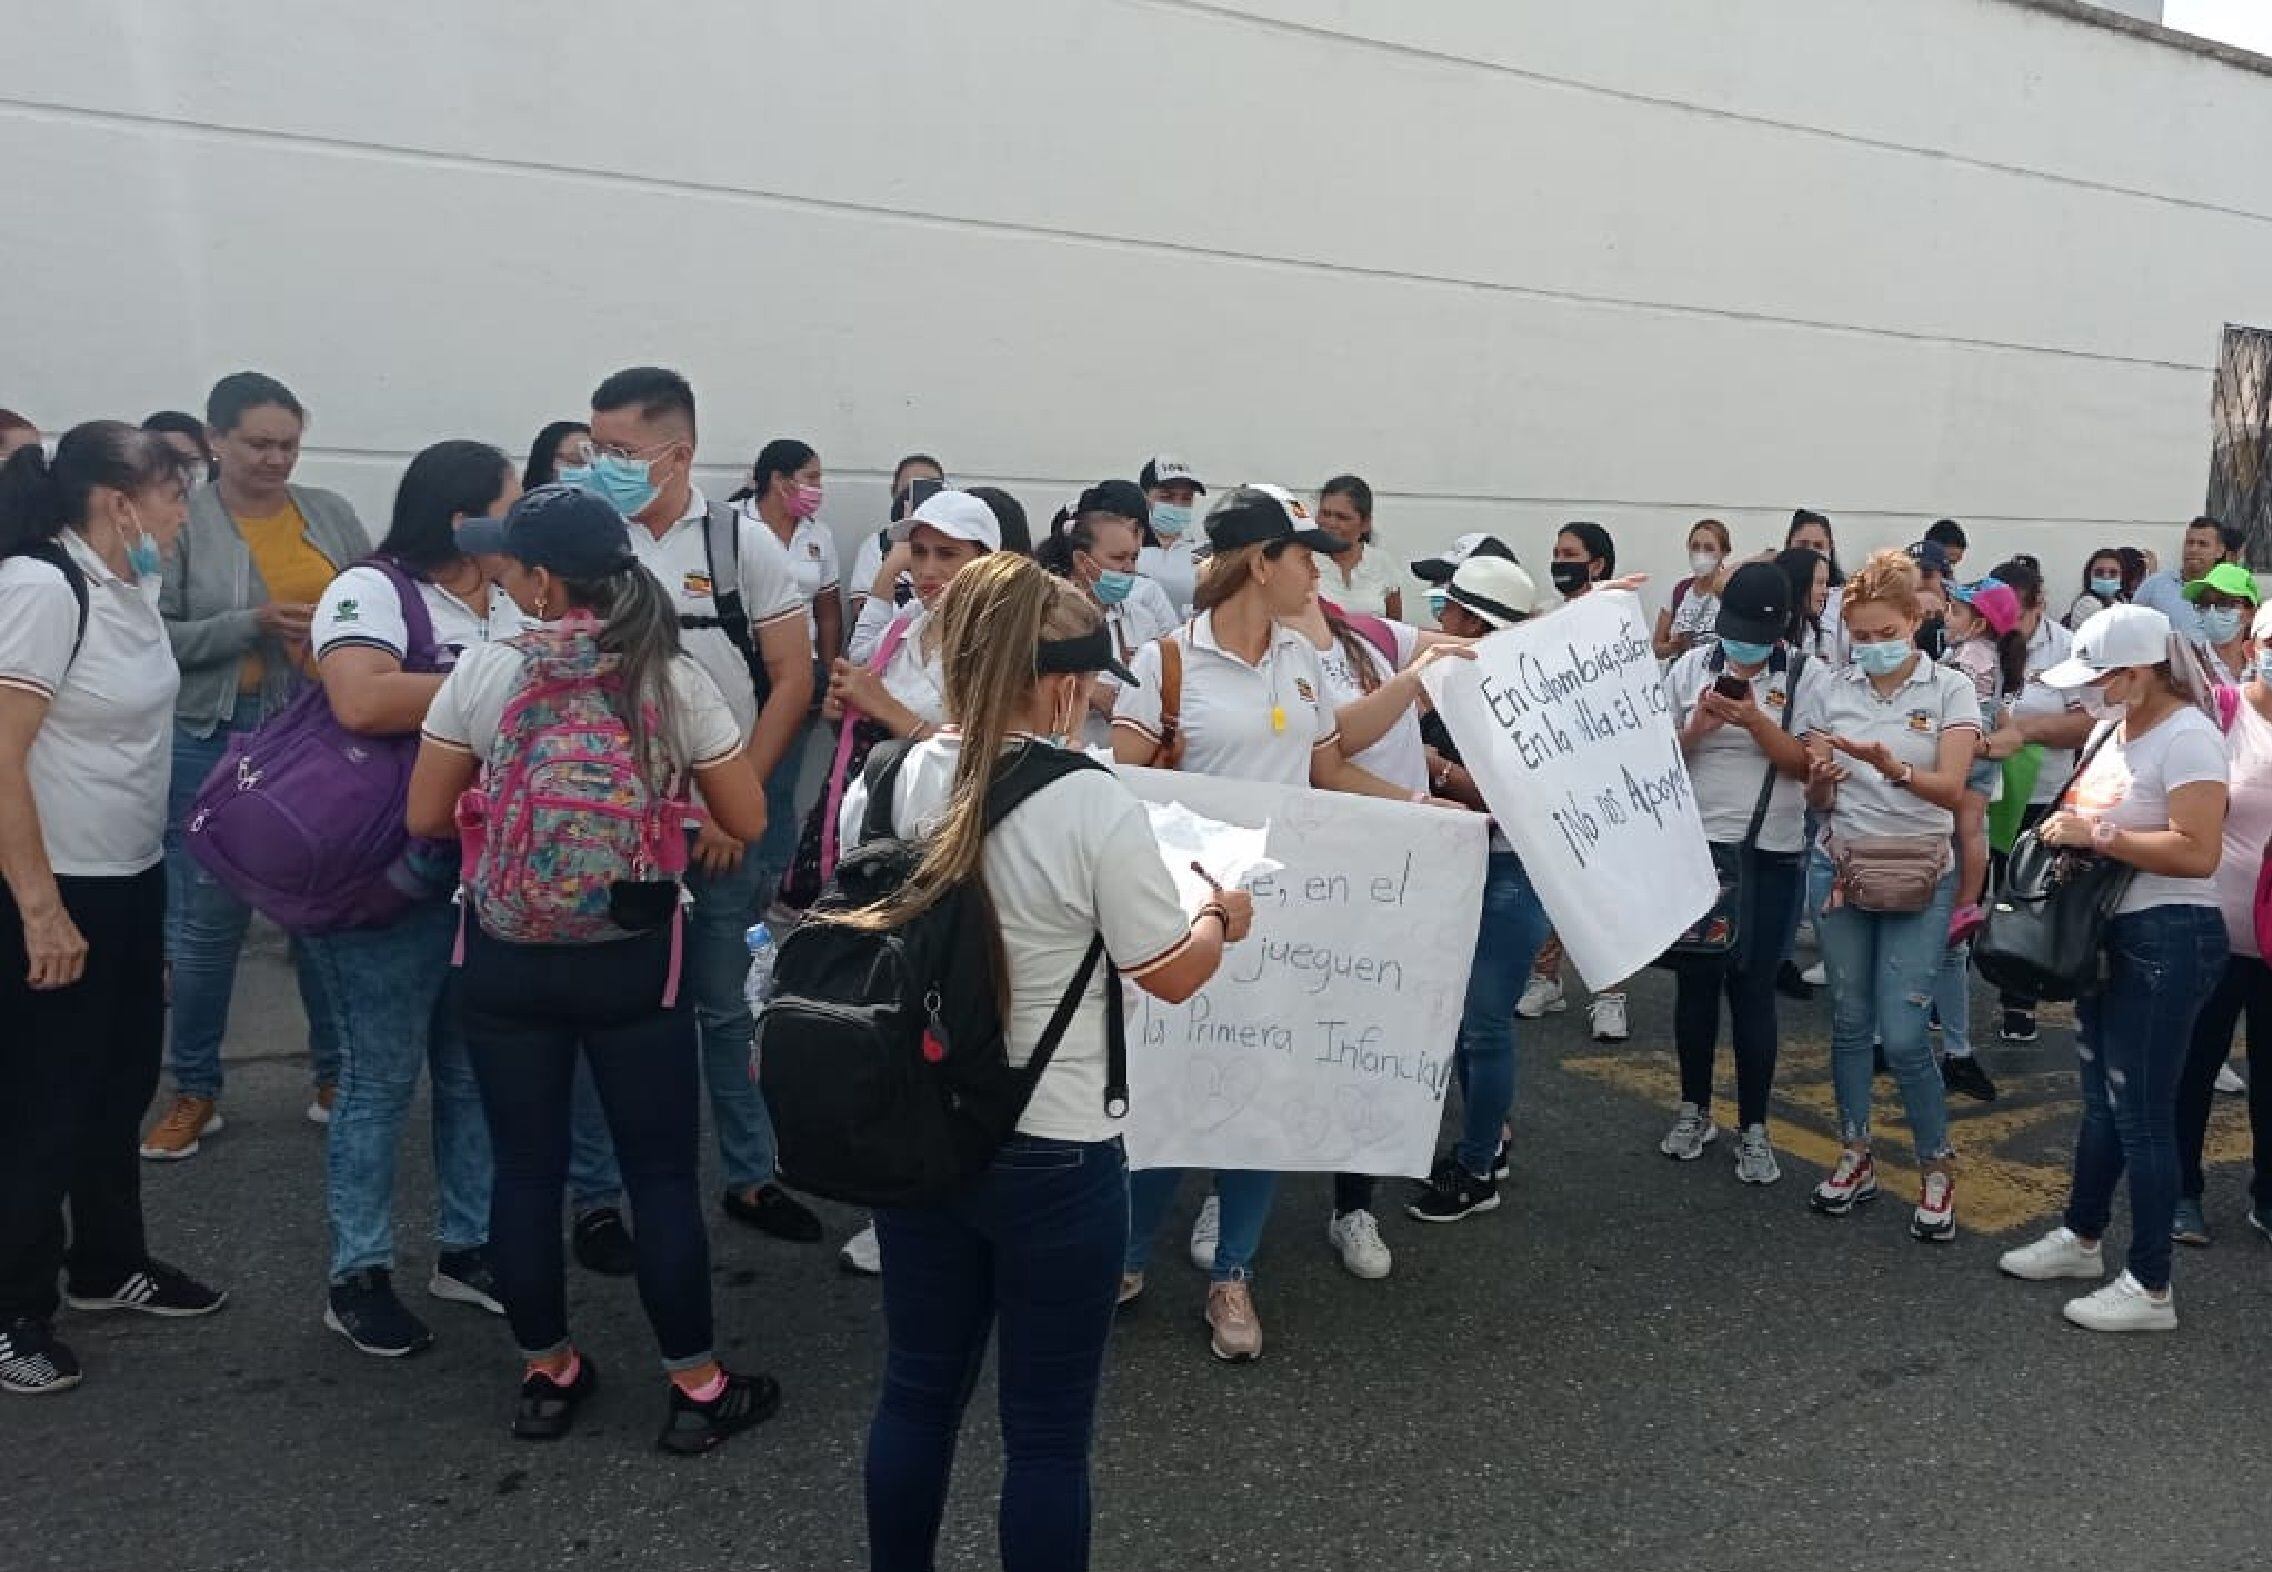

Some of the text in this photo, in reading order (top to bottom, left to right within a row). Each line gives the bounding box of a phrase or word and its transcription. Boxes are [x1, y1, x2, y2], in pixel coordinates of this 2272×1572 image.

[1480, 675, 1530, 728] En
[1511, 730, 1553, 770] En
[1305, 874, 1349, 907] en
[1370, 851, 1414, 908] el
[1232, 936, 1402, 995] jueguen
[1187, 993, 1294, 1055] Primera
